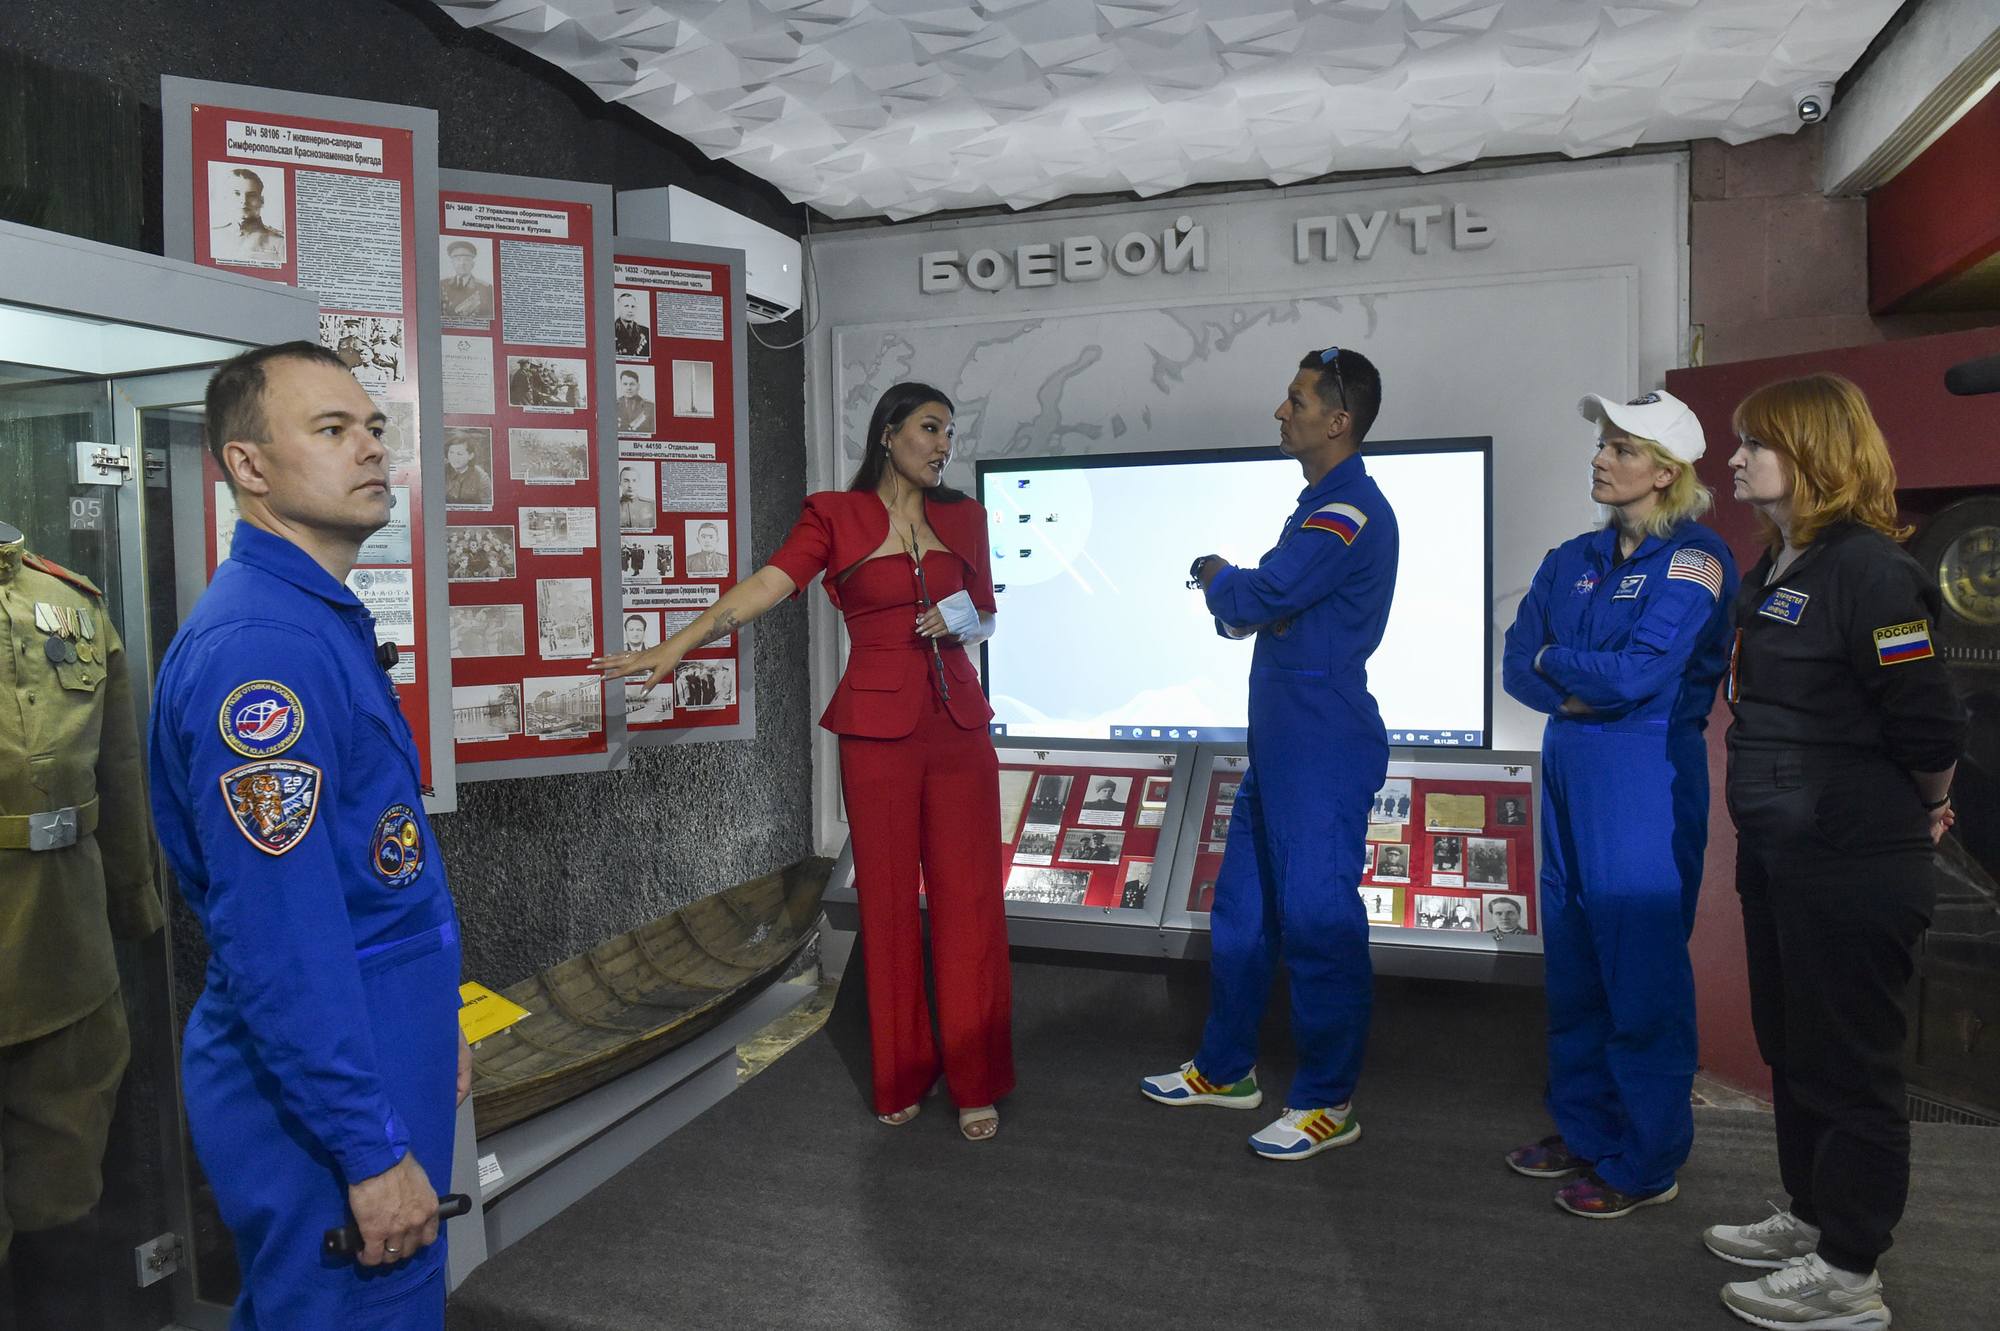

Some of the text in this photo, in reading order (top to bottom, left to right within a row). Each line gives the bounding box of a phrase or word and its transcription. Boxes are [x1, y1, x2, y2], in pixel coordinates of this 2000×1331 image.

[245, 125, 257, 138] В/ч
[260, 128, 280, 140] 58106
[292, 133, 363, 151] инженерно-саперная
[227, 138, 382, 166] Симферопольская Краснознаменная бригада
[486, 206, 518, 216] Управление
[519, 210, 566, 220] оборонительного
[462, 220, 494, 230] Александра
[495, 222, 520, 231] Невского
[527, 226, 551, 234] Кутузова
[474, 215, 538, 226] строительства орденов
[920, 203, 1497, 295] БОЕВОЙ ПУТЬ
[643, 267, 669, 276] Отдельная
[625, 276, 689, 287] инженерно-испытательная
[667, 443, 699, 451] Отдельная
[621, 451, 698, 460] инженерно-испытательная
[72, 499, 101, 518] 05
[1876, 623, 1923, 640] РОССИЯ
[282, 776, 302, 787] 29
